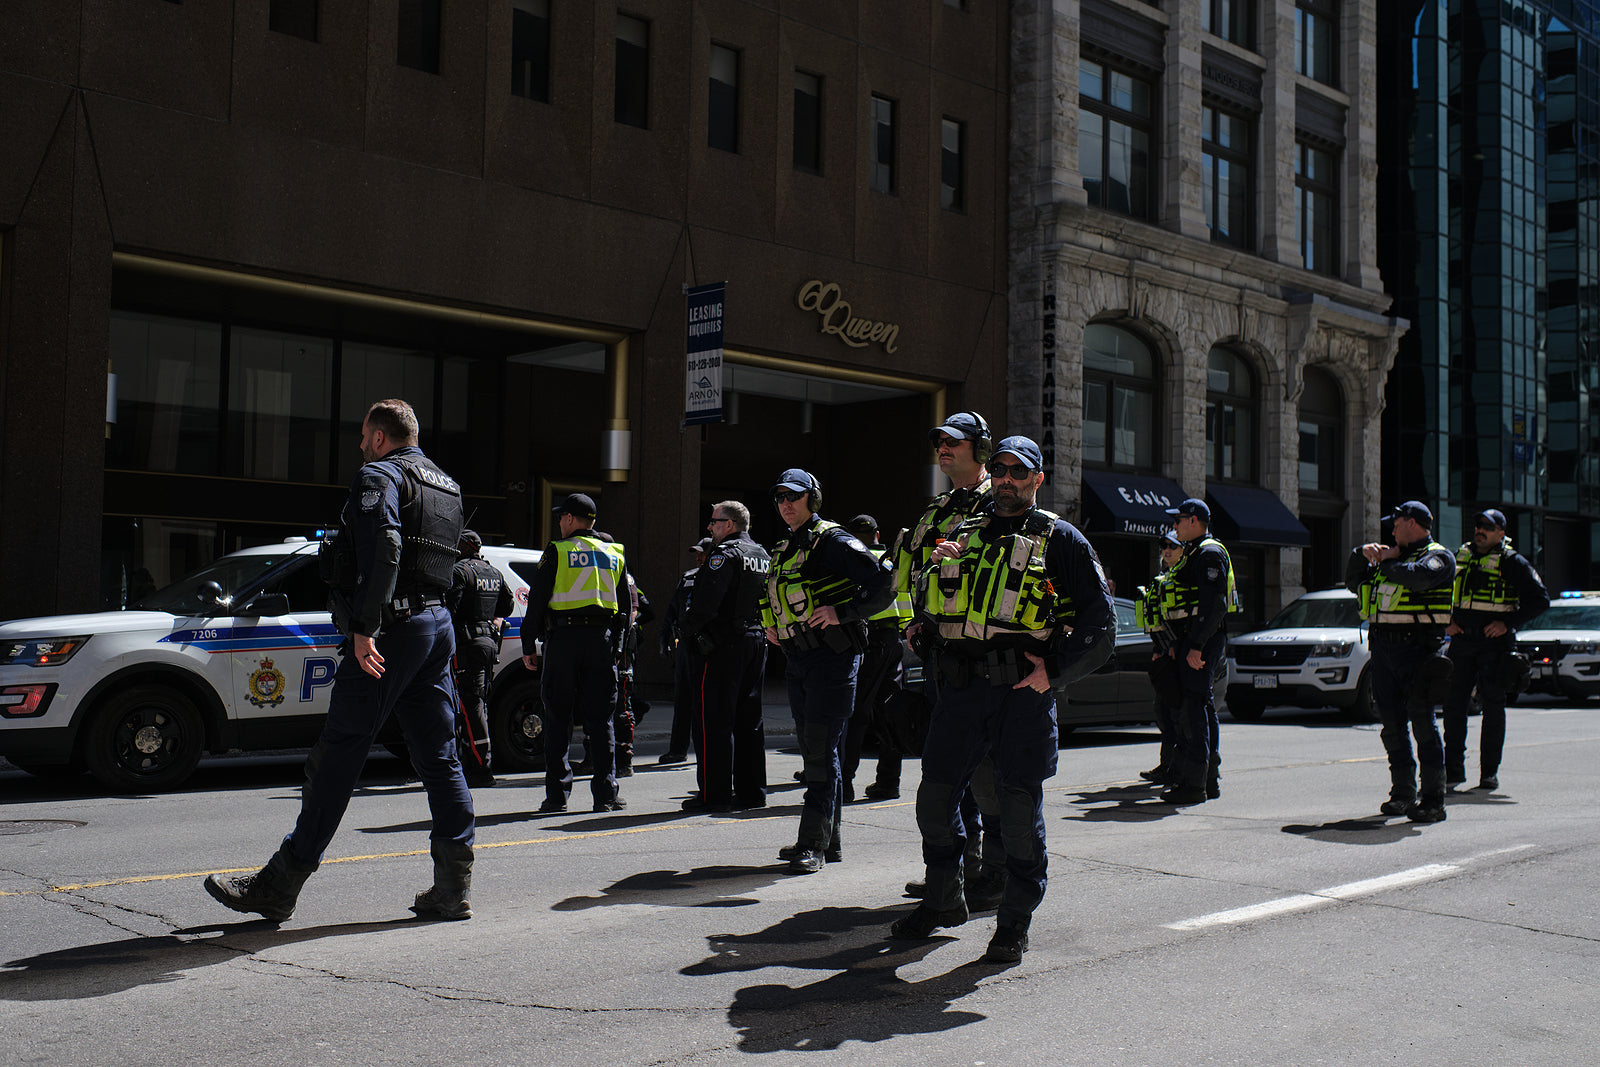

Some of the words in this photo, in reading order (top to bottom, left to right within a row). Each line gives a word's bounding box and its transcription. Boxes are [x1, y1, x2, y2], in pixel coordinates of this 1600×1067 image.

[689, 302, 723, 322] LEASING
[798, 279, 841, 315] 60
[821, 300, 900, 354] Queen
[689, 319, 722, 337] INQUIRIES
[688, 388, 720, 401] ARNON
[1042, 294, 1056, 486] RESTAURANT
[420, 467, 456, 491] POLICE
[743, 556, 770, 574] POLIC
[476, 578, 500, 592] POLICE
[191, 629, 218, 640] 7206
